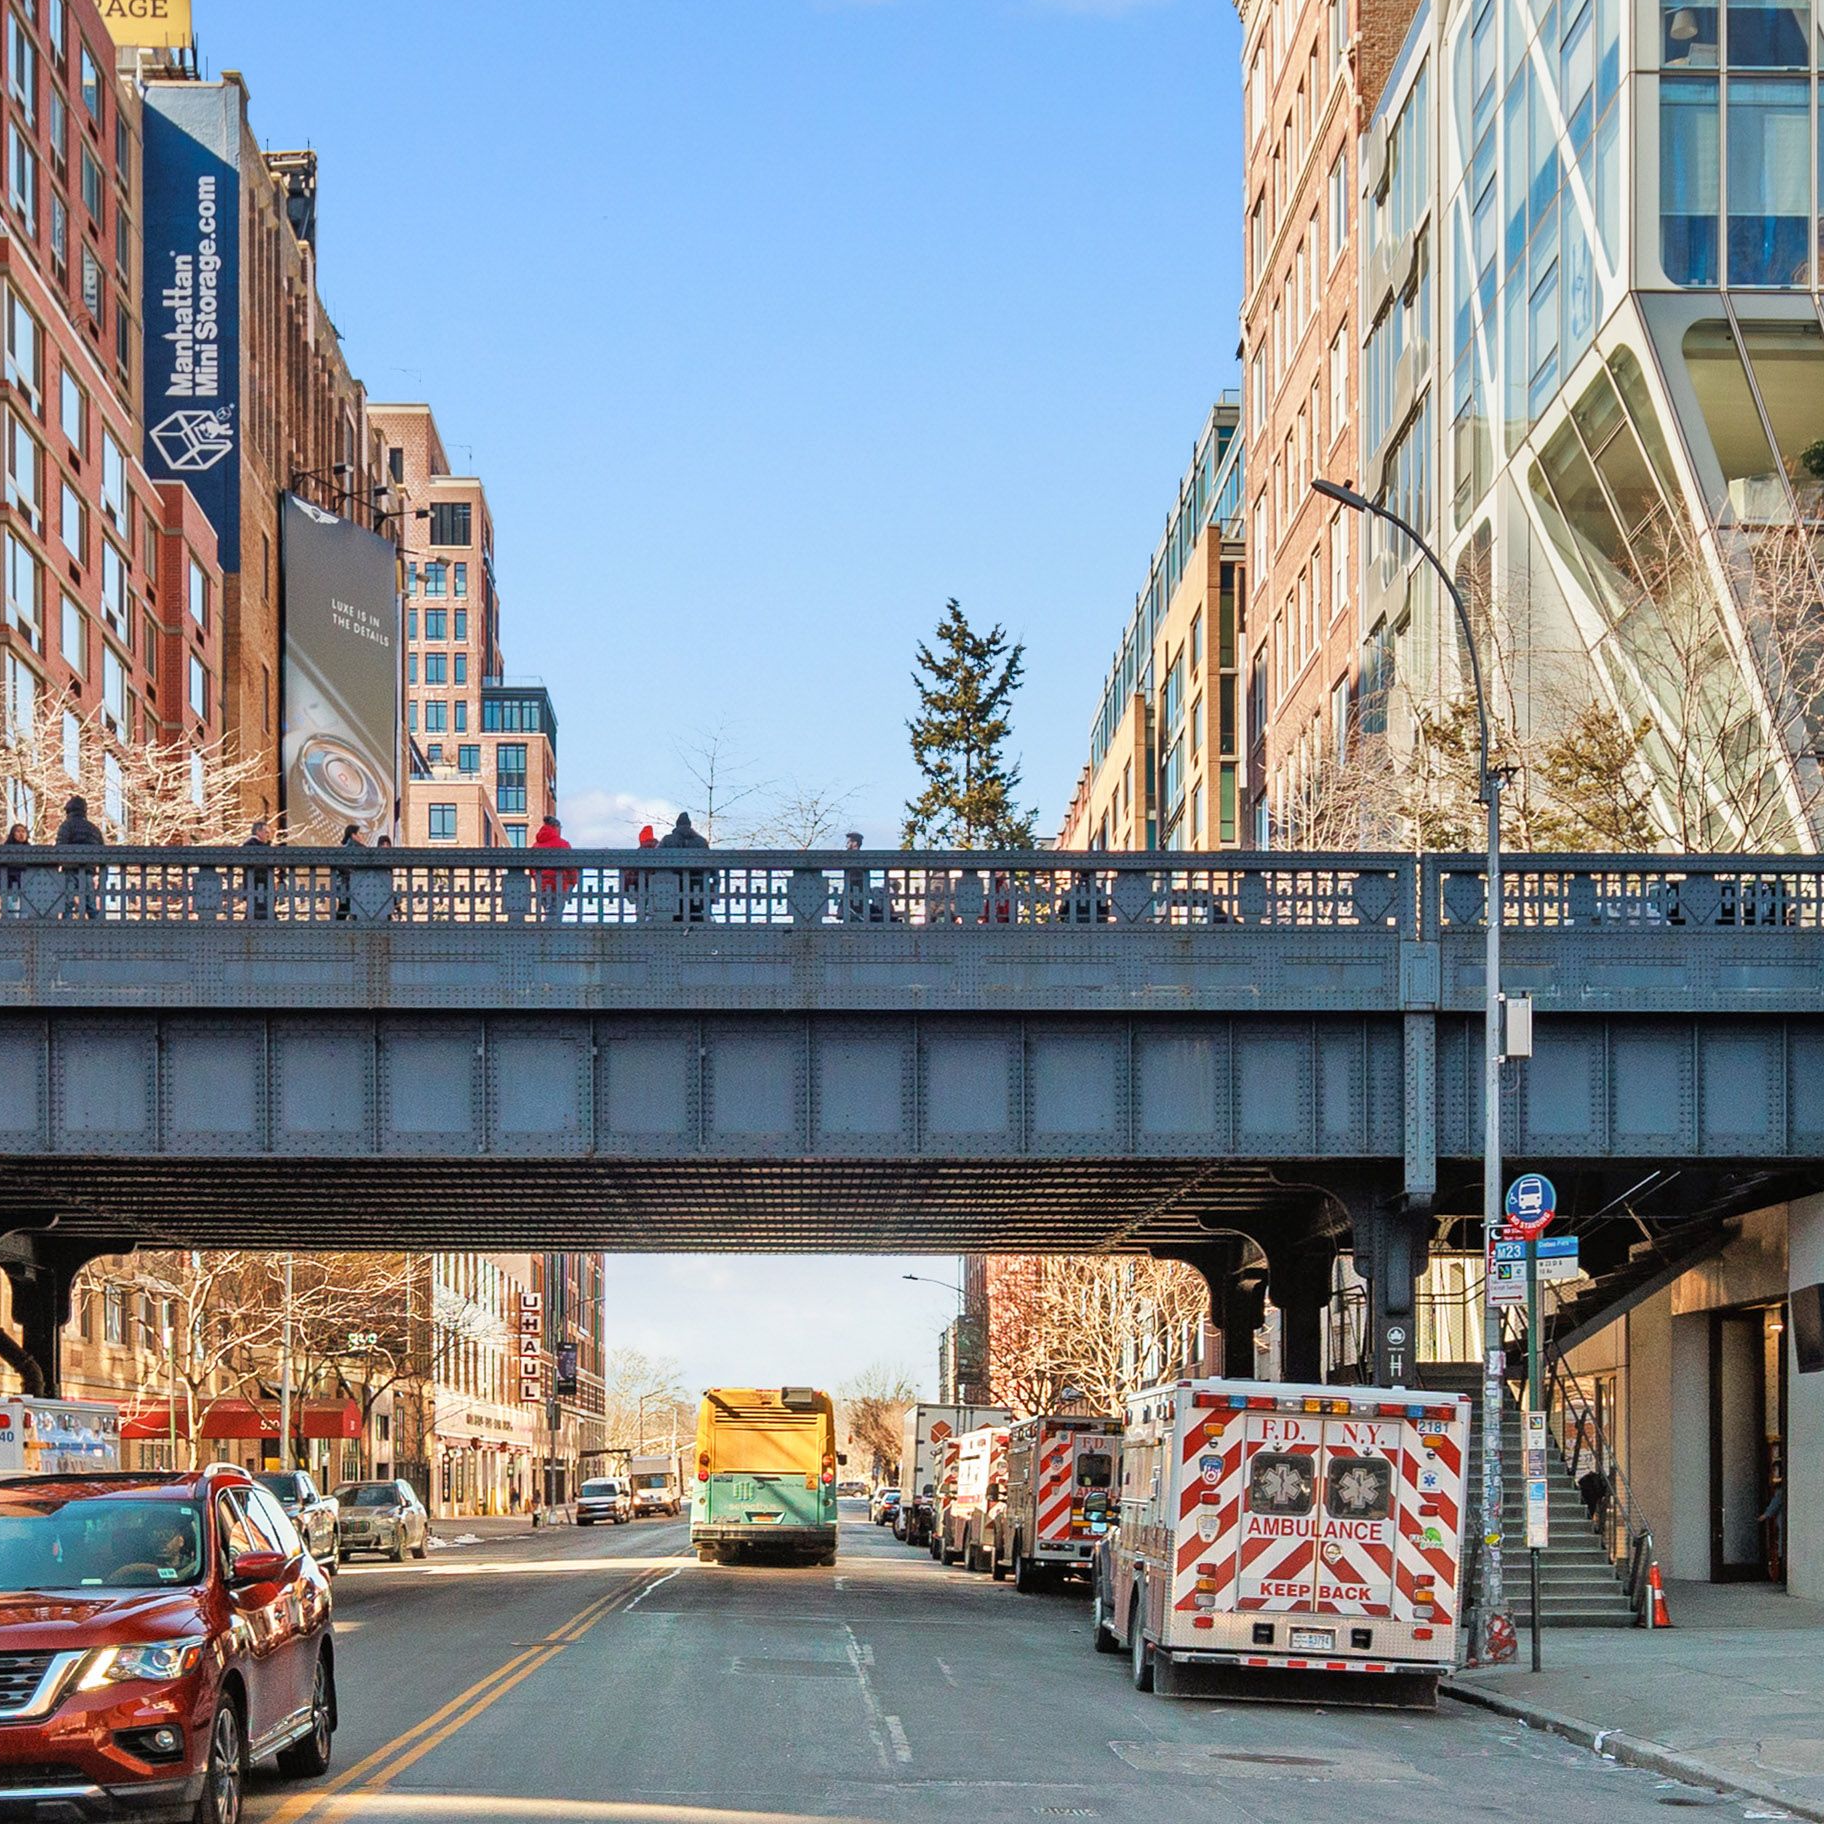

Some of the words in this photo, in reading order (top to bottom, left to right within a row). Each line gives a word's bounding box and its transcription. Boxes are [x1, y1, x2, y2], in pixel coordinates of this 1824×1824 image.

[194, 175, 222, 341] Storage.com
[161, 254, 194, 397] Manhattan
[195, 343, 218, 397] Mini
[331, 598, 354, 617] LUXE
[357, 609, 367, 623] IS
[369, 615, 380, 628] IN
[333, 613, 351, 630] THE
[353, 622, 389, 647] DETAILS
[1497, 1245, 1522, 1258] M23
[1261, 1419, 1306, 1441] F.D.
[1342, 1423, 1385, 1445] N.Y.
[1417, 1420, 1449, 1434] 2181
[1081, 1436, 1107, 1450] F.D.
[1247, 1517, 1383, 1541] AMBULANCE
[1260, 1582, 1311, 1597] KEEP
[1319, 1585, 1372, 1601] BACK
